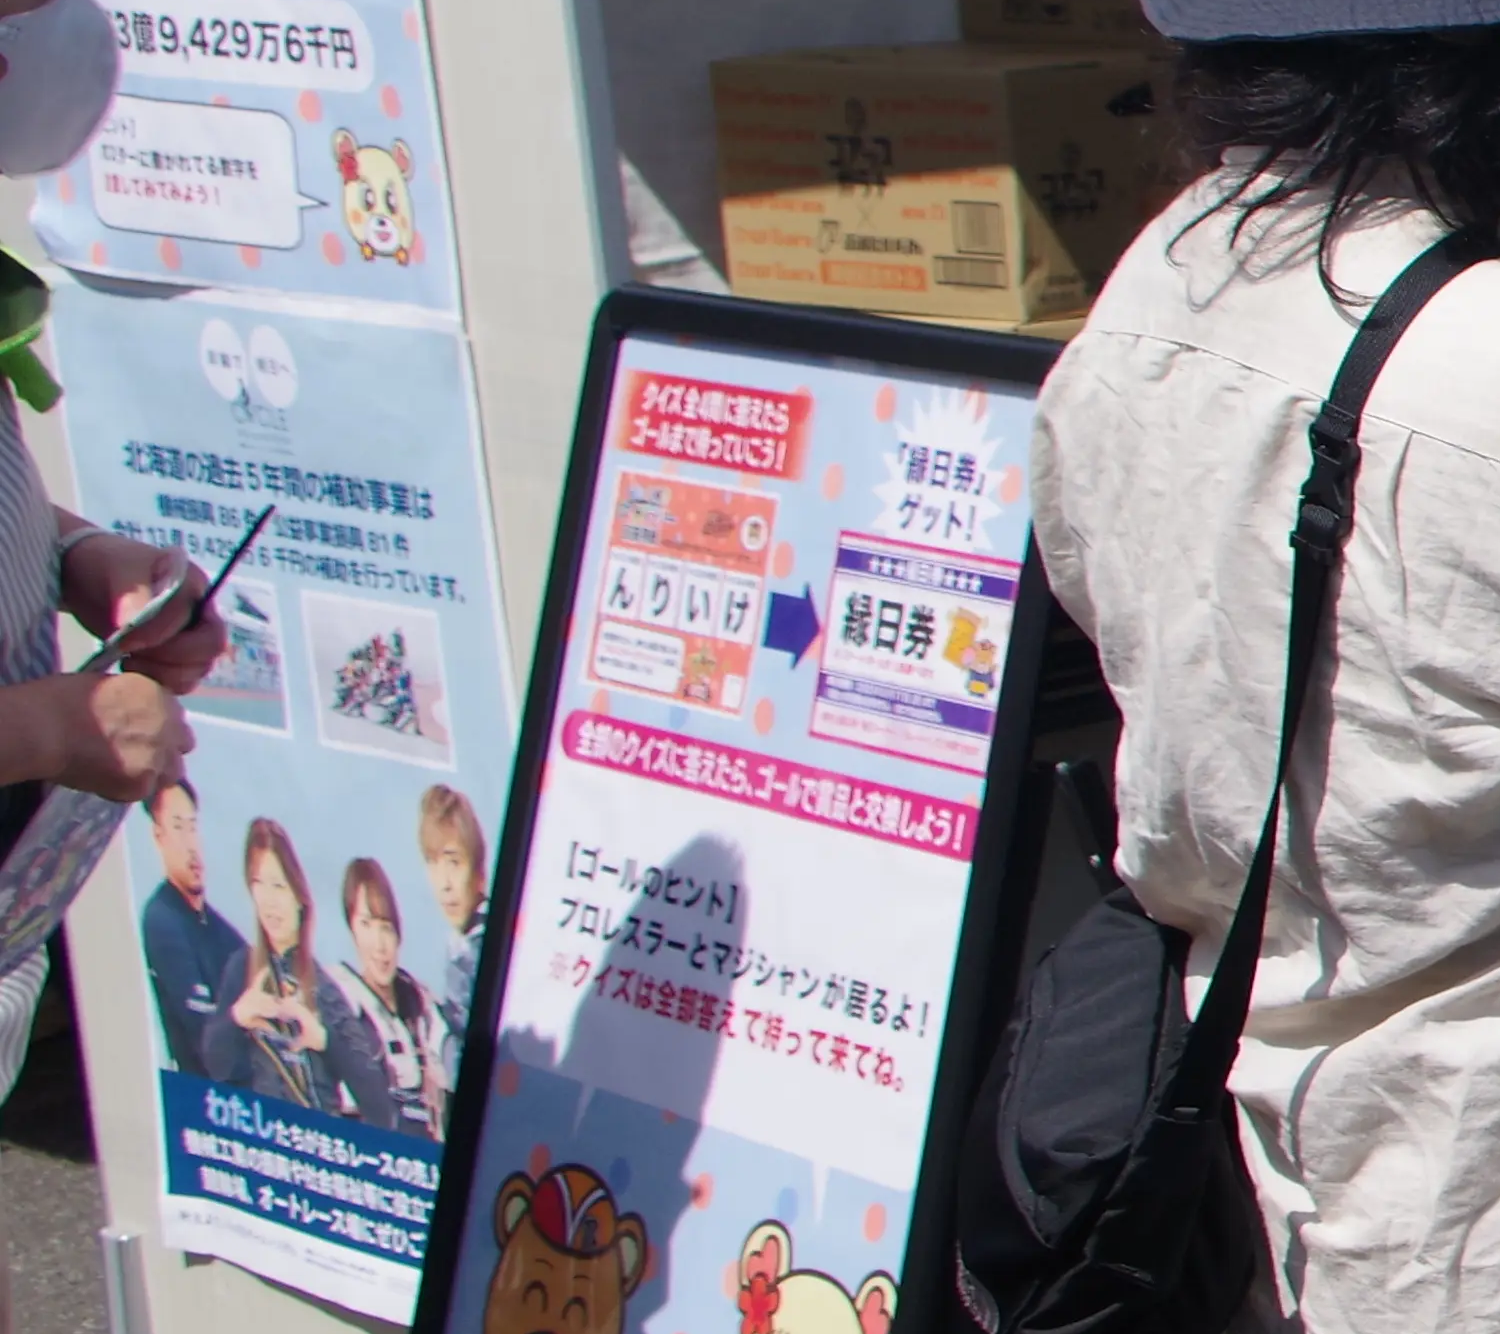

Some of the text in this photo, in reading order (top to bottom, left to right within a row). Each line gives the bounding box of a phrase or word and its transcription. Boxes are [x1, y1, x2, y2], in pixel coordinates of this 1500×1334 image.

[107, 10, 358, 69] 3億9,429万6千円
[608, 567, 635, 611] ん
[650, 573, 672, 618] り
[687, 584, 711, 624] い
[724, 589, 750, 635] け
[841, 590, 939, 661] 縁日券
